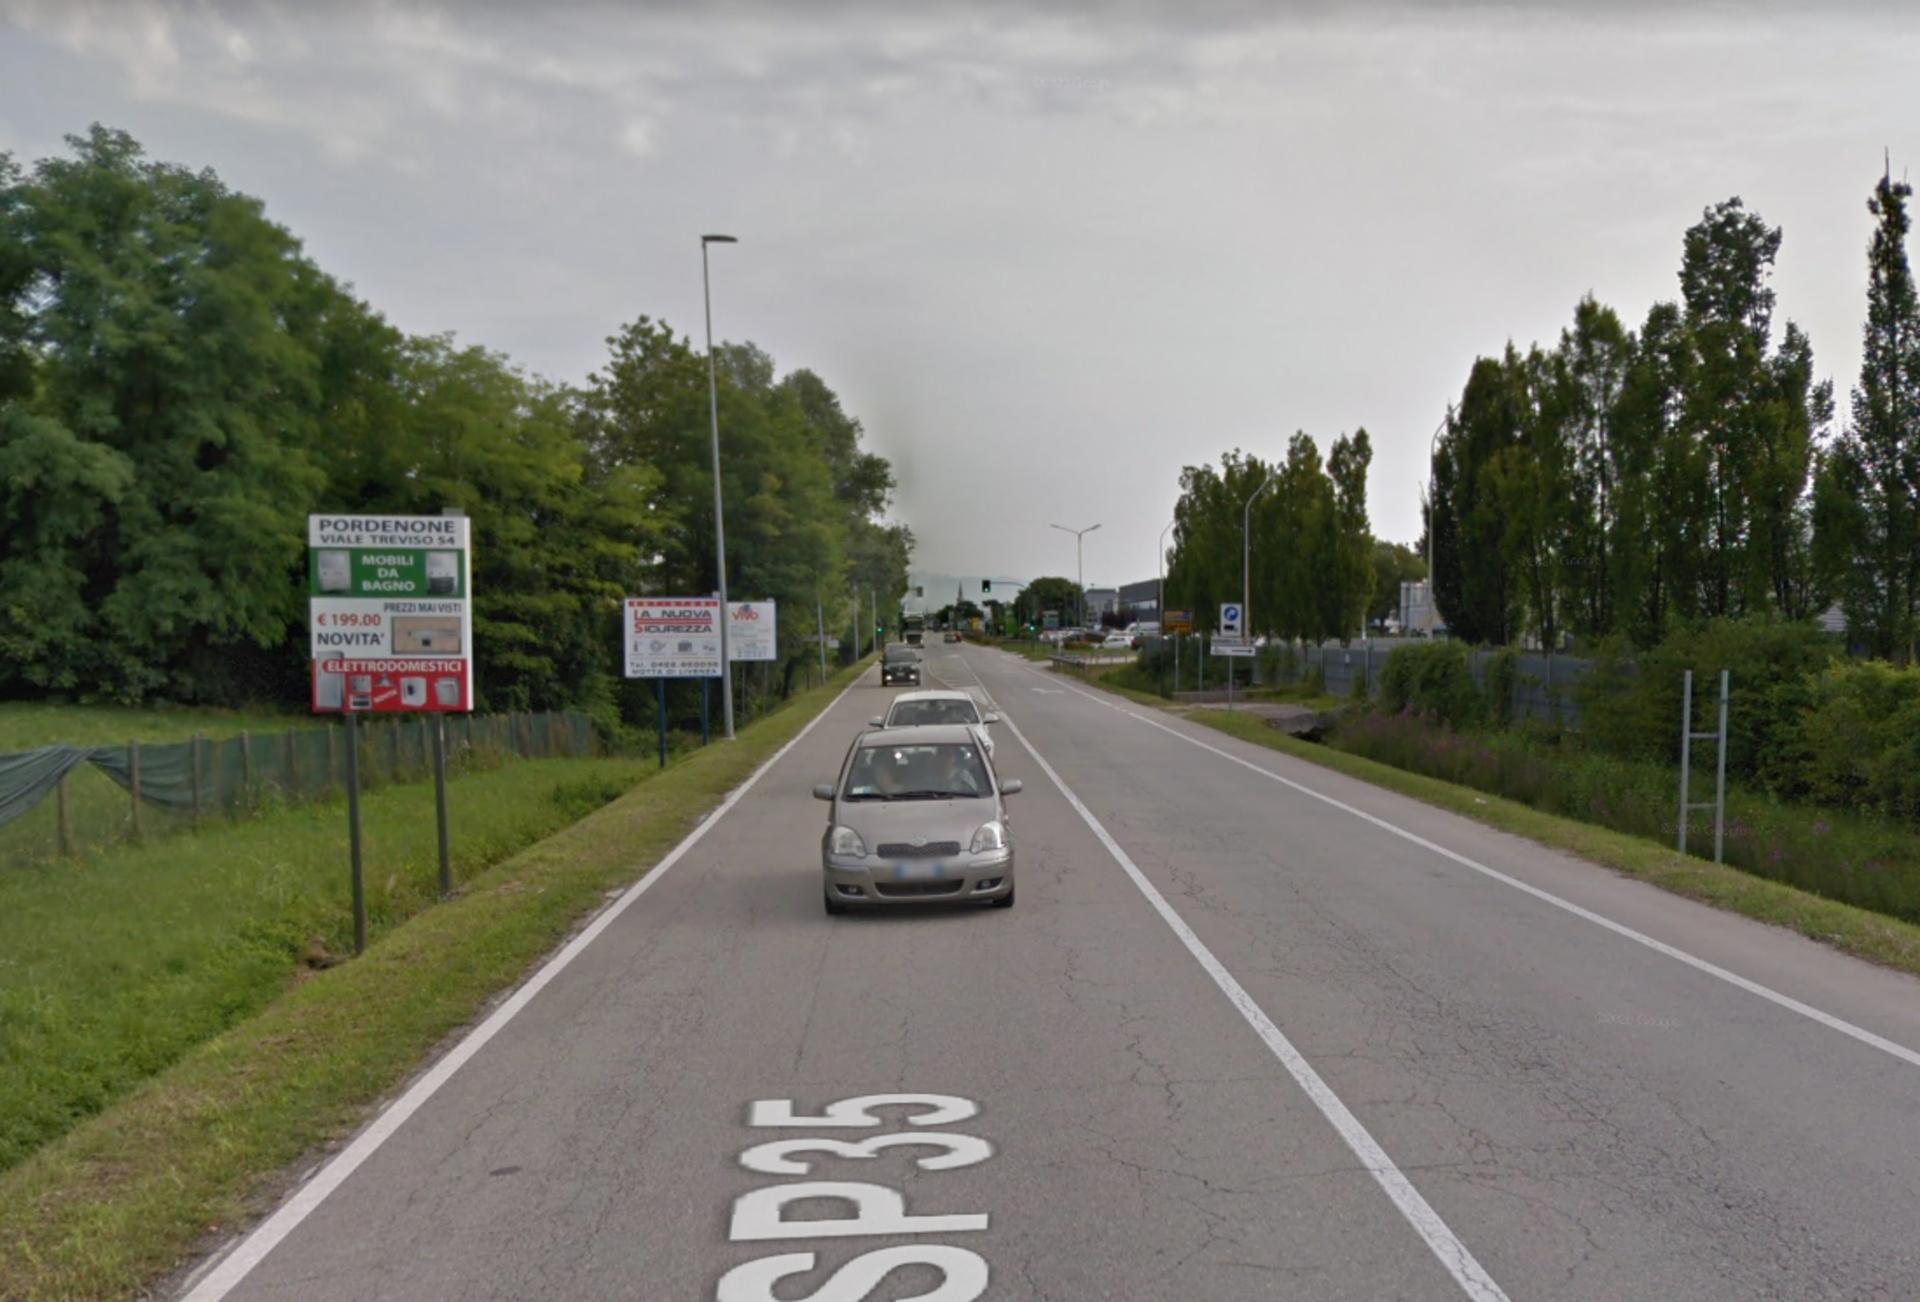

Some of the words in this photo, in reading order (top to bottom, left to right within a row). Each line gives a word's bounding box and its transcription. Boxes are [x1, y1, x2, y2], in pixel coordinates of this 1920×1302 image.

[319, 519, 456, 534] PORDENONE
[320, 534, 364, 544] VIALE
[369, 534, 434, 545] TREVISO
[437, 535, 456, 545] 54
[362, 555, 414, 566] MOBILI
[377, 568, 399, 578] DA
[362, 581, 415, 592] BAGNO
[383, 602, 417, 613] PREZZI
[418, 602, 437, 613] MAI
[438, 602, 462, 613] VISTI
[331, 613, 381, 626] 199.00
[634, 609, 650, 621] LA
[661, 609, 712, 618] NUOVA
[634, 623, 712, 634] SICUREZZA
[317, 633, 385, 646] NOVITA'
[327, 660, 462, 672] ELETTRODOMESTICI
[716, 1093, 992, 1302] SP35
